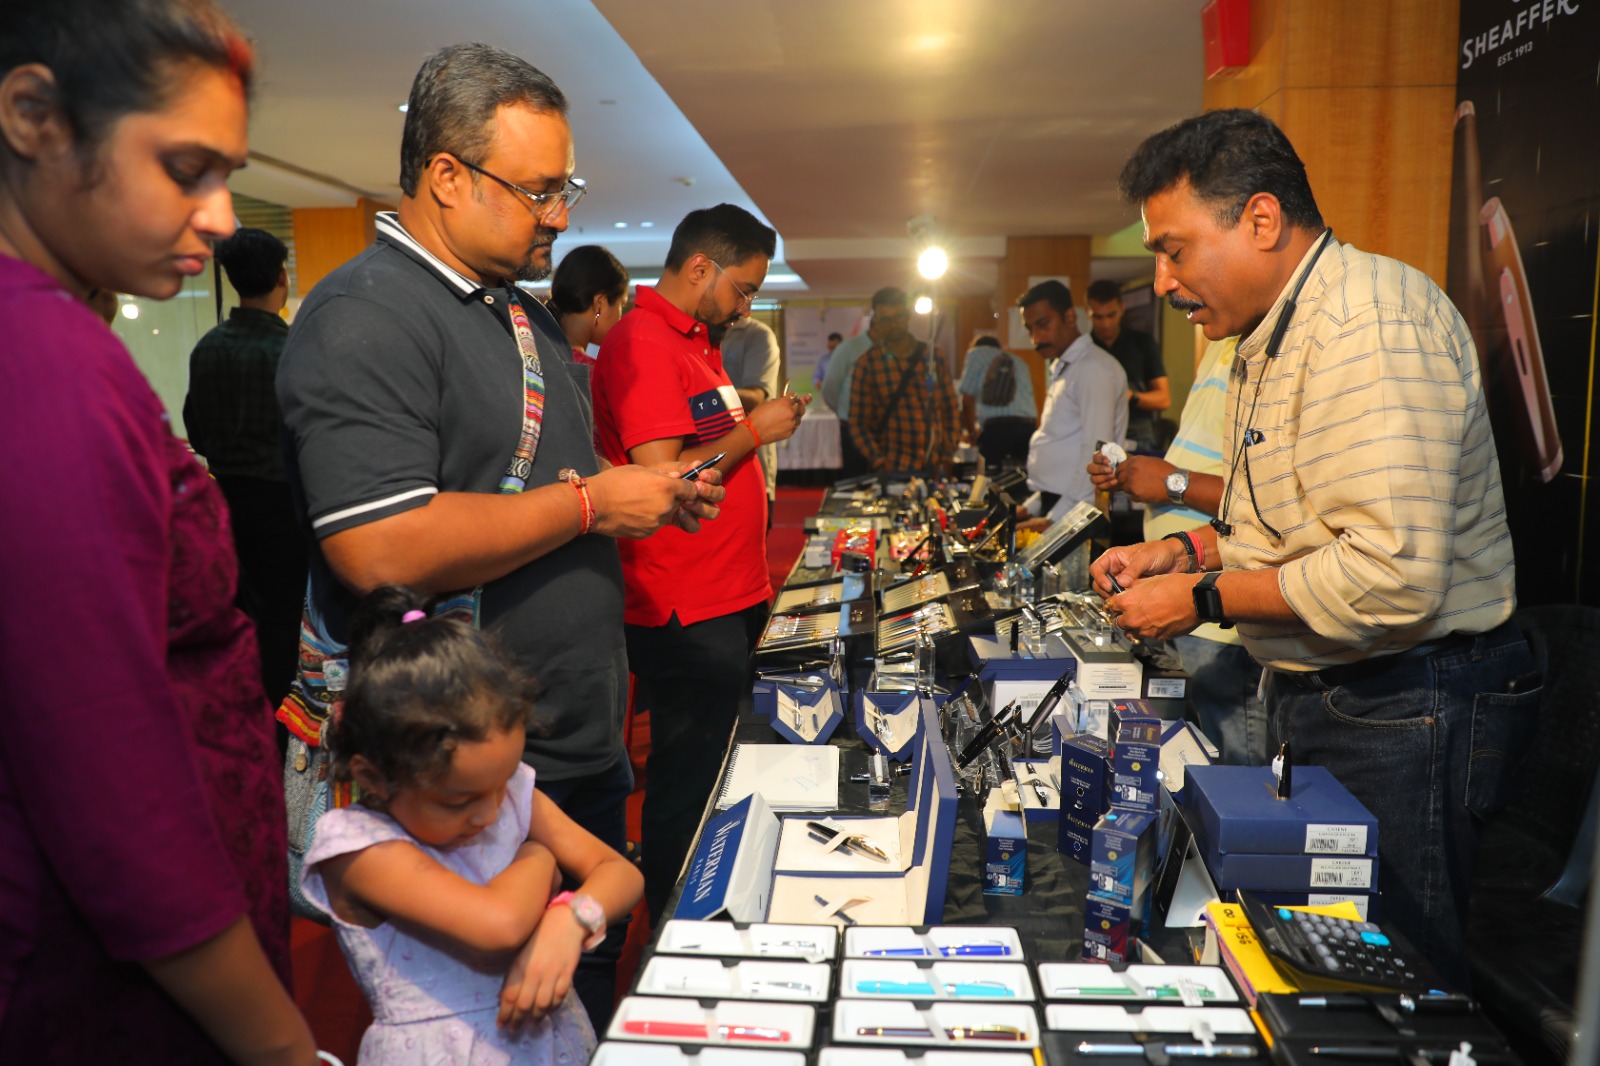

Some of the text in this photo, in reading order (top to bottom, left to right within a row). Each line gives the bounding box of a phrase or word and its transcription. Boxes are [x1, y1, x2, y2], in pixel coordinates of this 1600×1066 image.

[1462, 0, 1580, 69] SHEAFFER
[1515, 41, 1534, 58] 1913
[693, 820, 741, 903] WATERMAN
